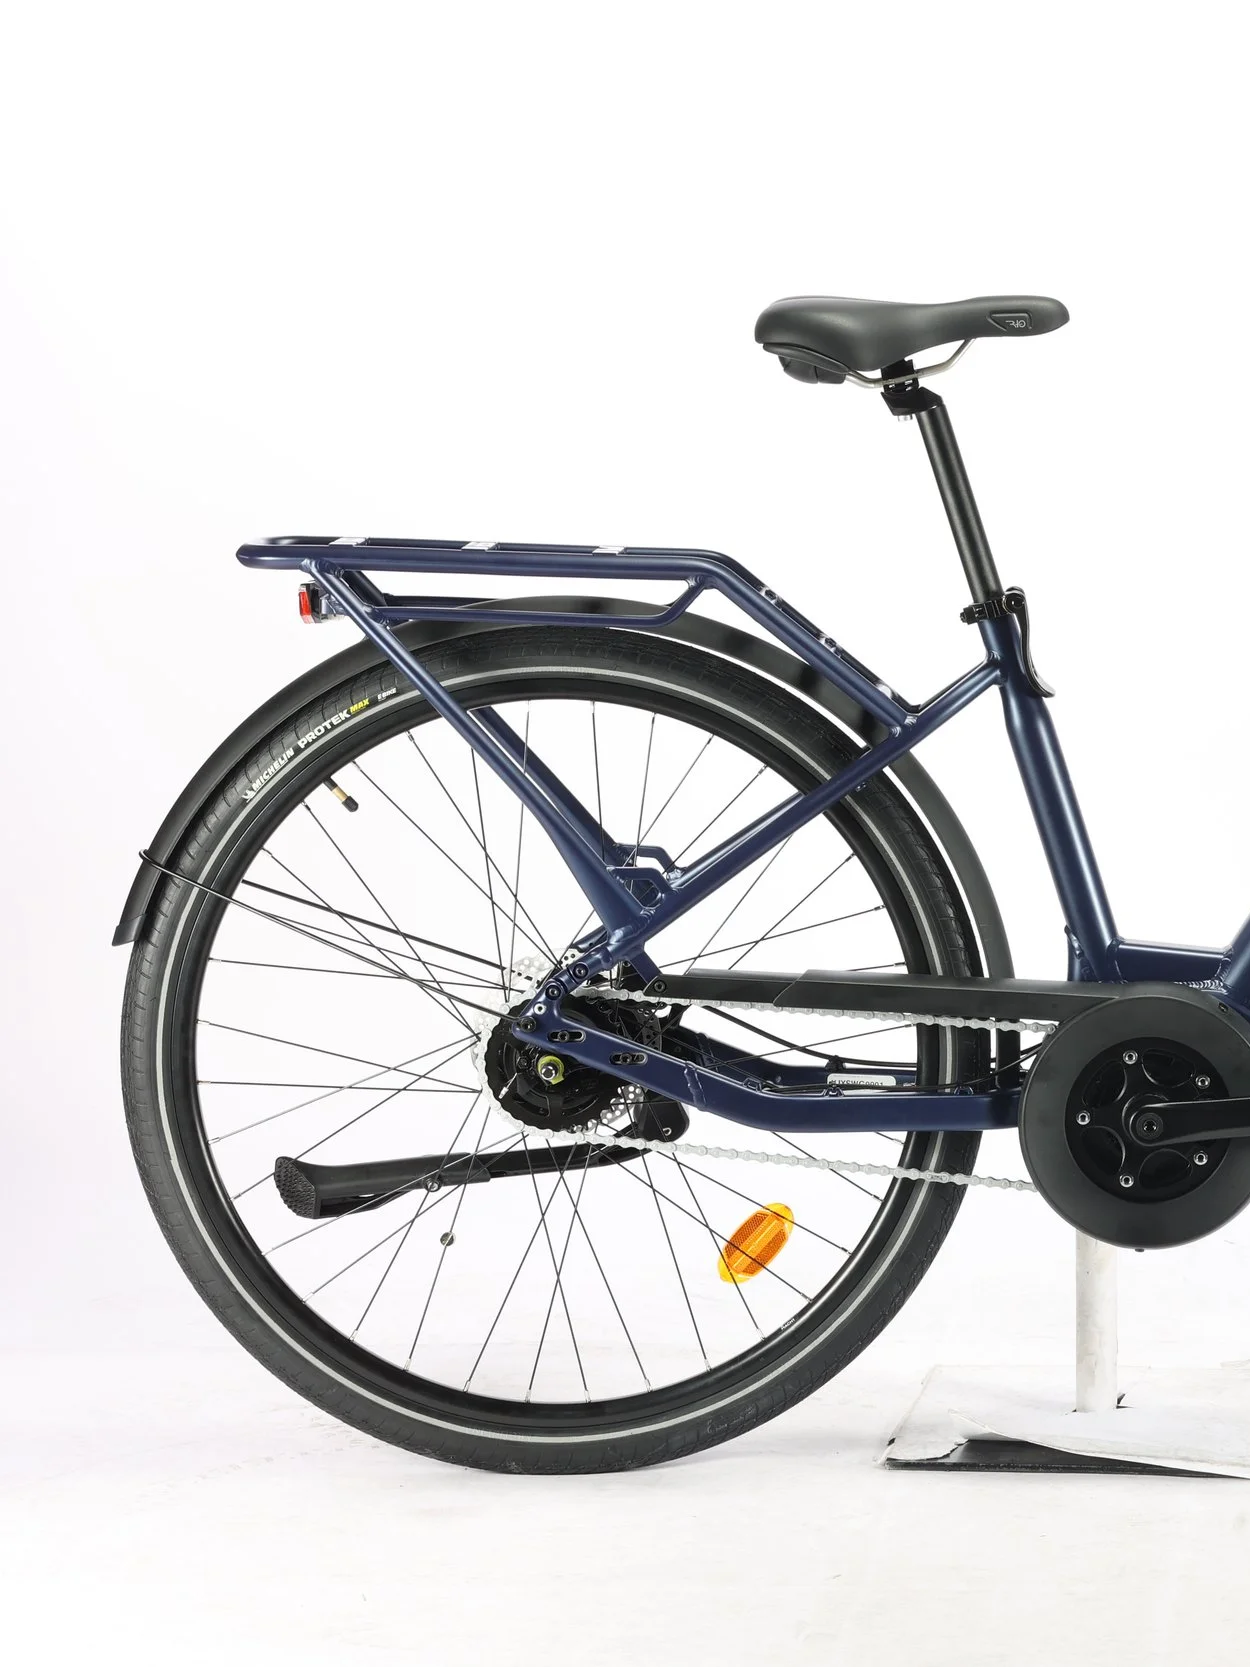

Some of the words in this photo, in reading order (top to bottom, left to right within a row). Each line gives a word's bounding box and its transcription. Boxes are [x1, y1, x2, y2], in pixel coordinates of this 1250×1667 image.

[251, 748, 295, 791] MICHELIN
[297, 709, 351, 749] PROTEK
[349, 698, 370, 715] MAX
